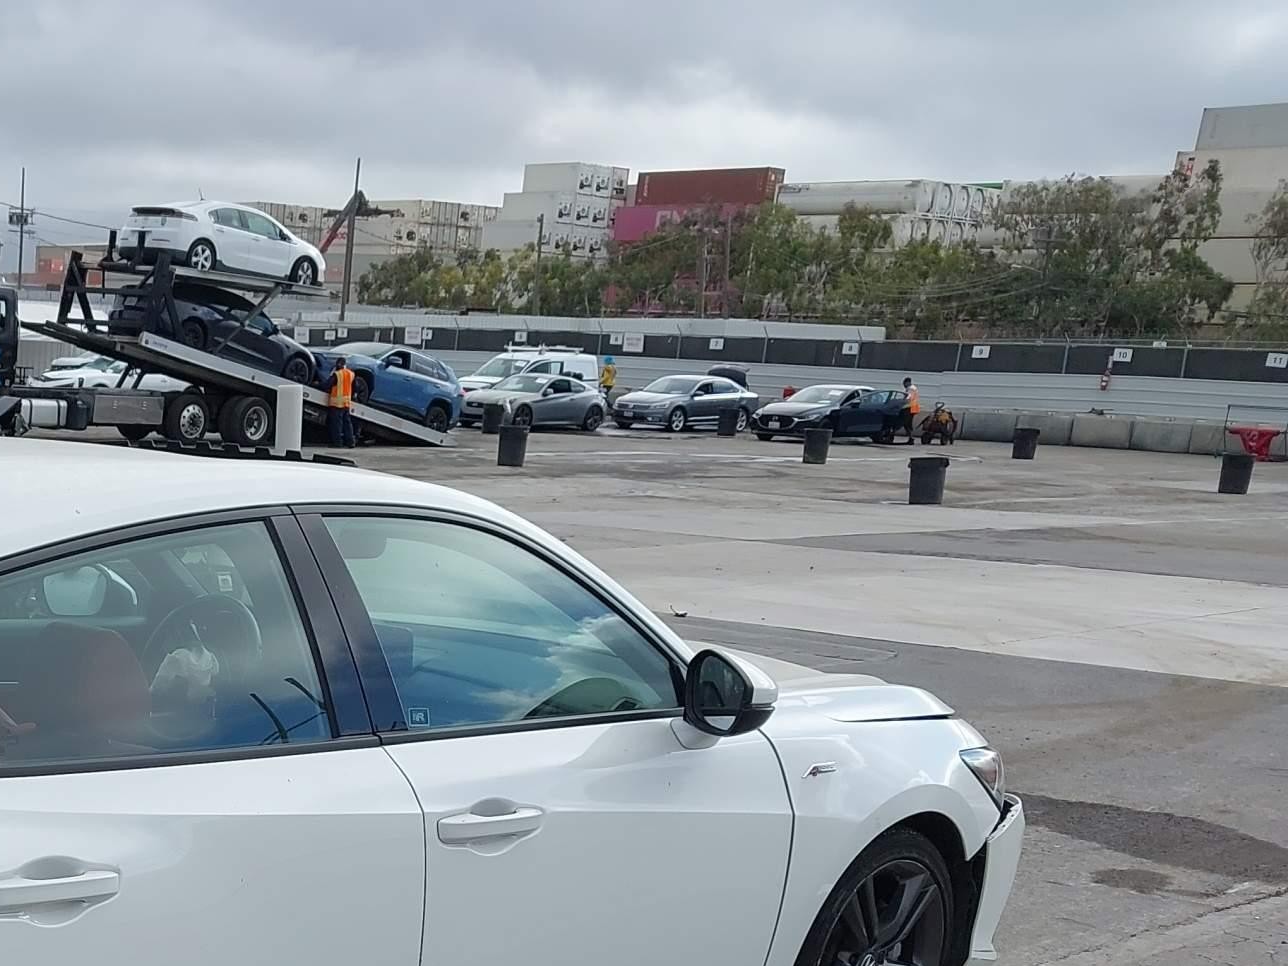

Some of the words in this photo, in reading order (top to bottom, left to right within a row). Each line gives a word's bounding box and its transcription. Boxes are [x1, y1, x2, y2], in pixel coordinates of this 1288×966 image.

[978, 348, 984, 356] 9
[1117, 351, 1128, 360] 10
[1272, 357, 1283, 365] 11
